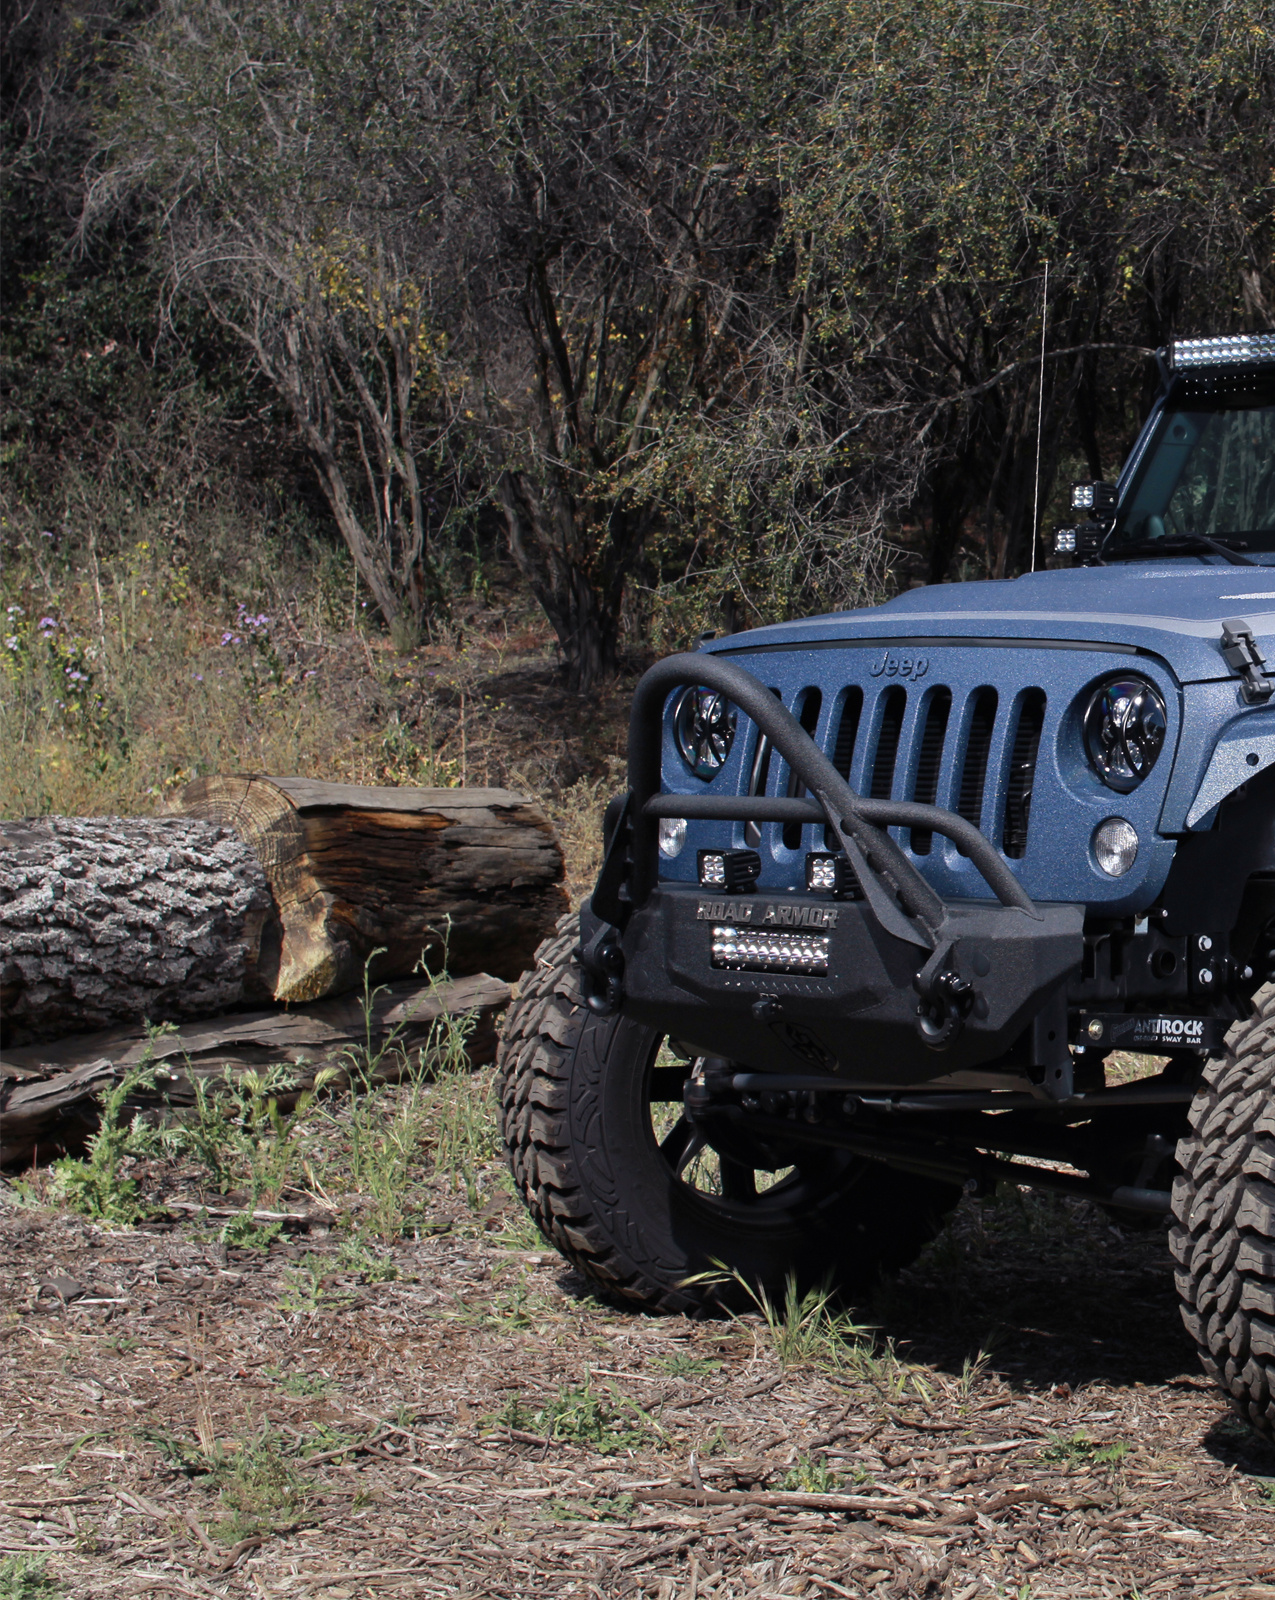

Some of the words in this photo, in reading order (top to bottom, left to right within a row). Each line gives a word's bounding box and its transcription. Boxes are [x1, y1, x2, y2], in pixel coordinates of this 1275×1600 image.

[869, 651, 930, 681] Jeep
[696, 901, 754, 923] ROAD
[762, 905, 838, 929] ARMOR
[1134, 1018, 1203, 1036] ANTIROCK
